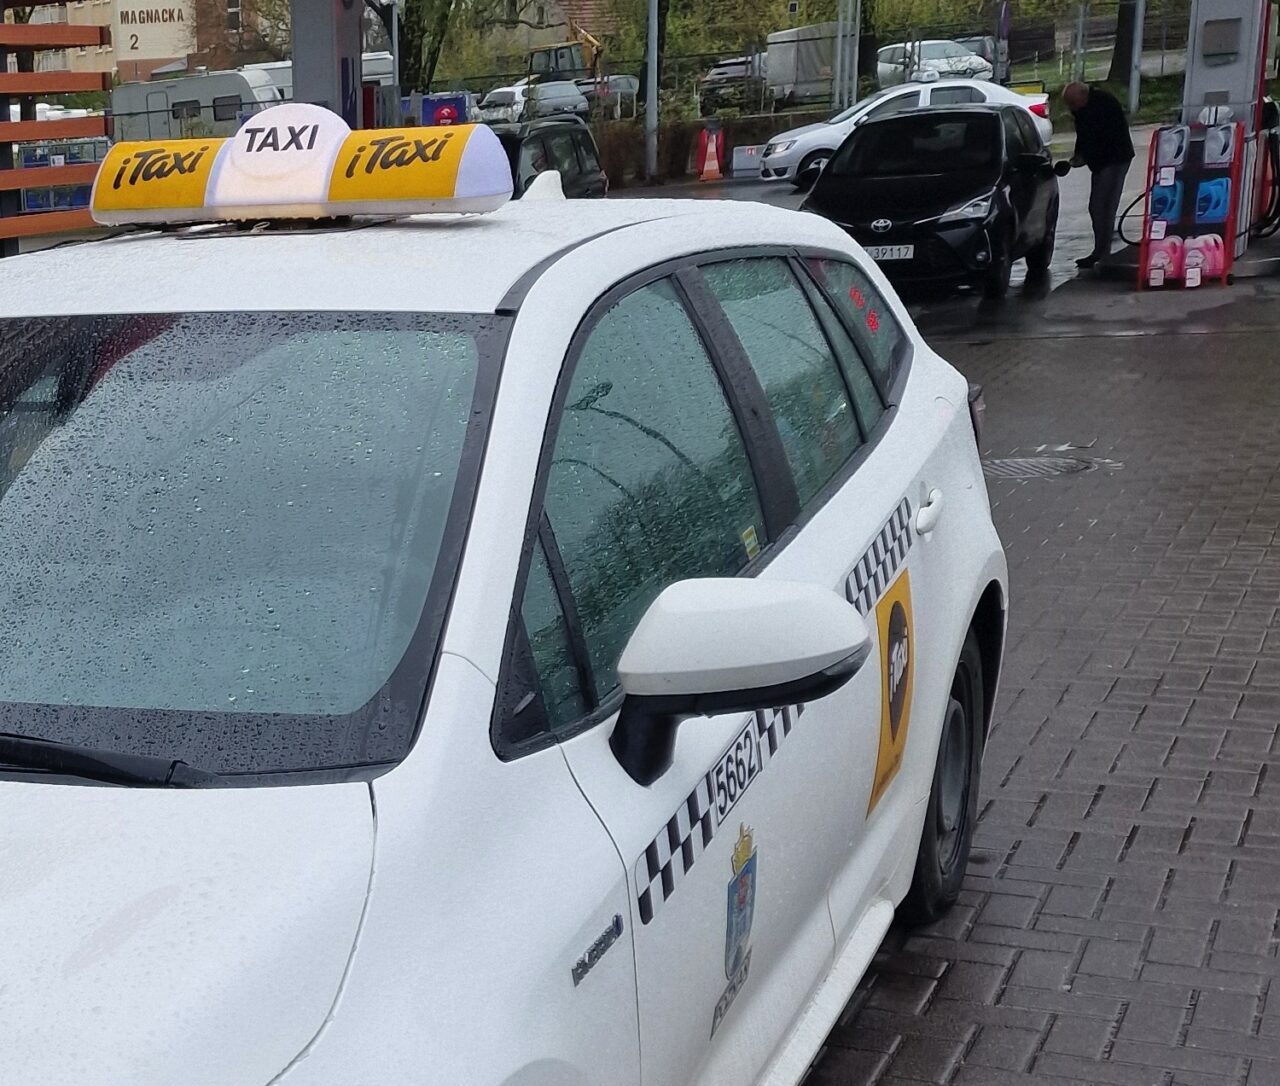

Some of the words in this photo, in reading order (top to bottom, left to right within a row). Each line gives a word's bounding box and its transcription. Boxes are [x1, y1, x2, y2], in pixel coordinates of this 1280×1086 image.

[120, 8, 185, 25] MAGNACKA
[130, 34, 140, 50] 2
[244, 124, 320, 153] TAXI
[113, 145, 210, 190] iTaxi
[345, 132, 454, 178] iTaxi
[873, 247, 910, 259] 39117
[716, 737, 758, 816] 5662
